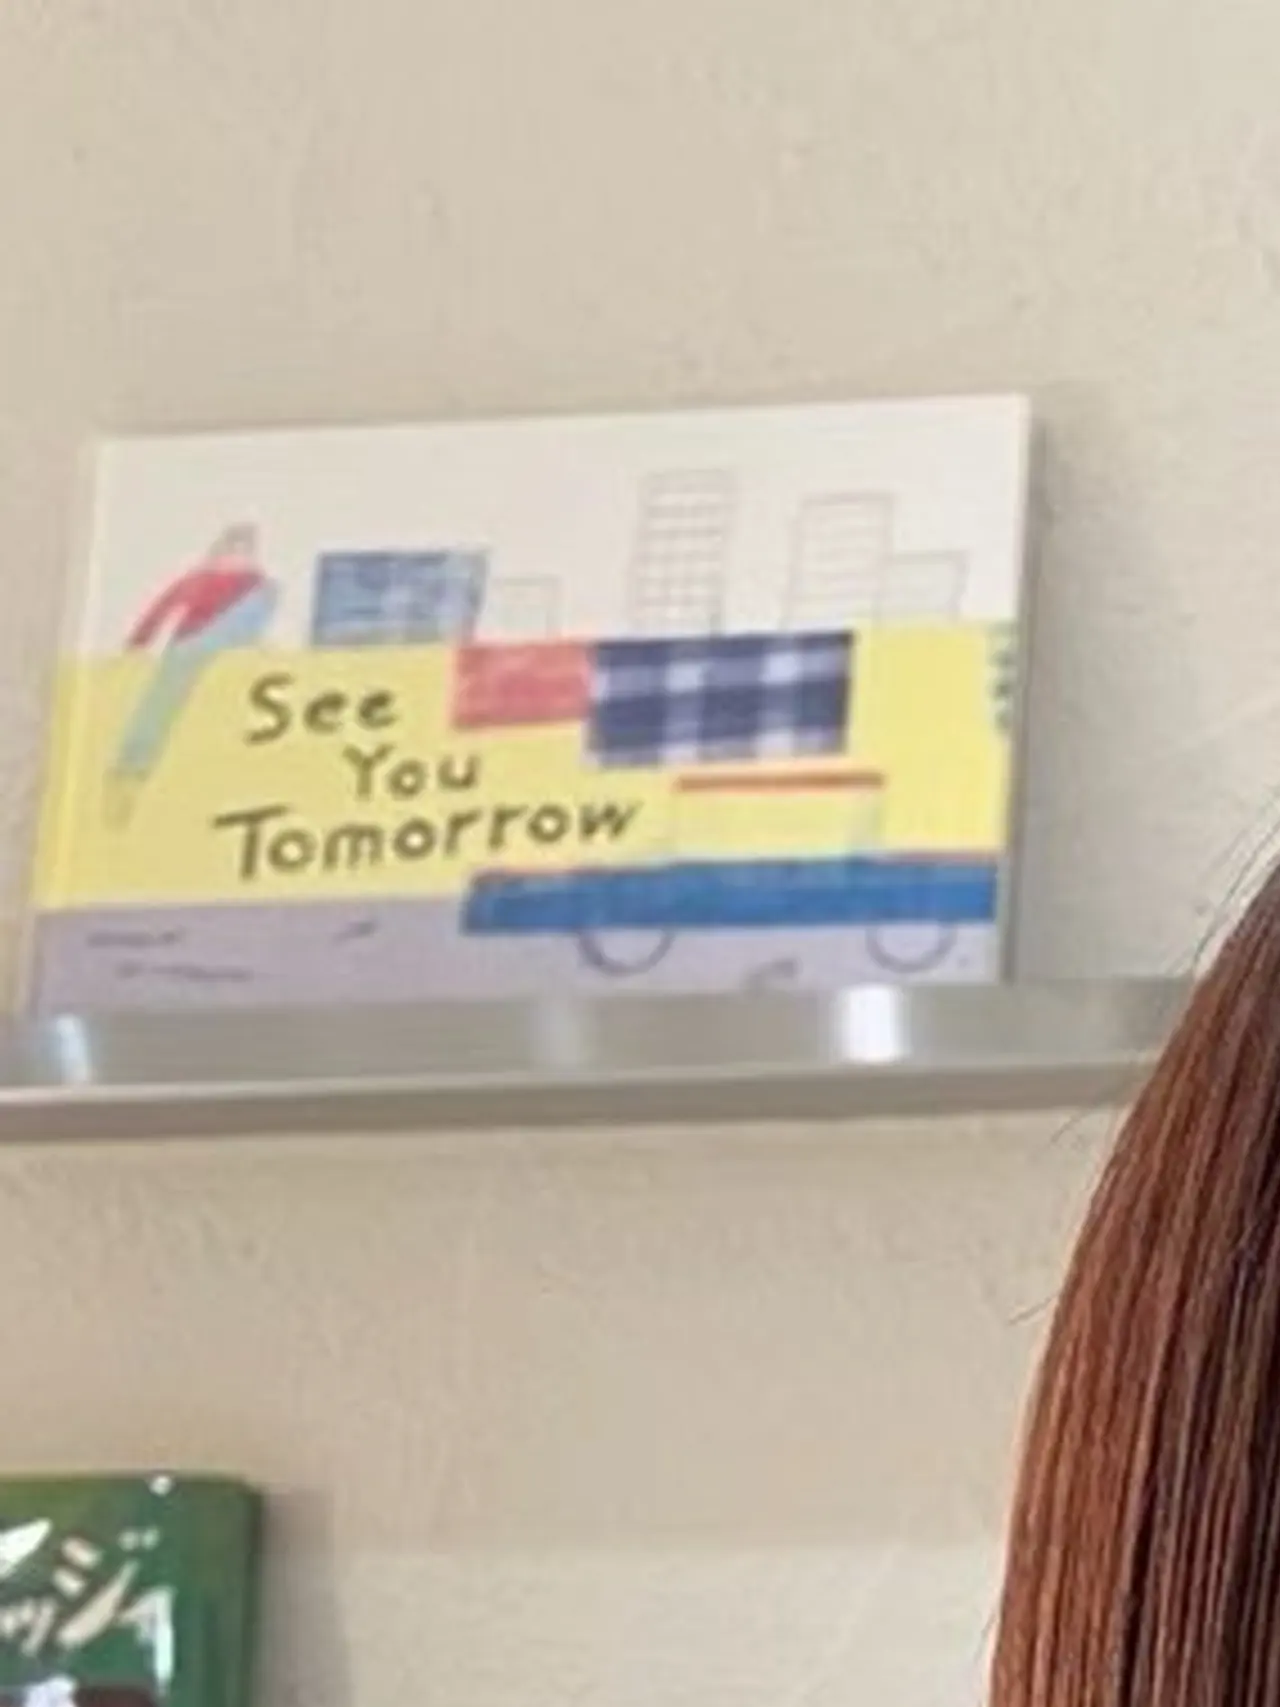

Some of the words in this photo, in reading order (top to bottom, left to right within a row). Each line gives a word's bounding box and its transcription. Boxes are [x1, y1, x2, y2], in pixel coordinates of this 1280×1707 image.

[243, 672, 399, 746] See
[343, 743, 480, 799] You
[212, 801, 643, 881] Tomorrow
